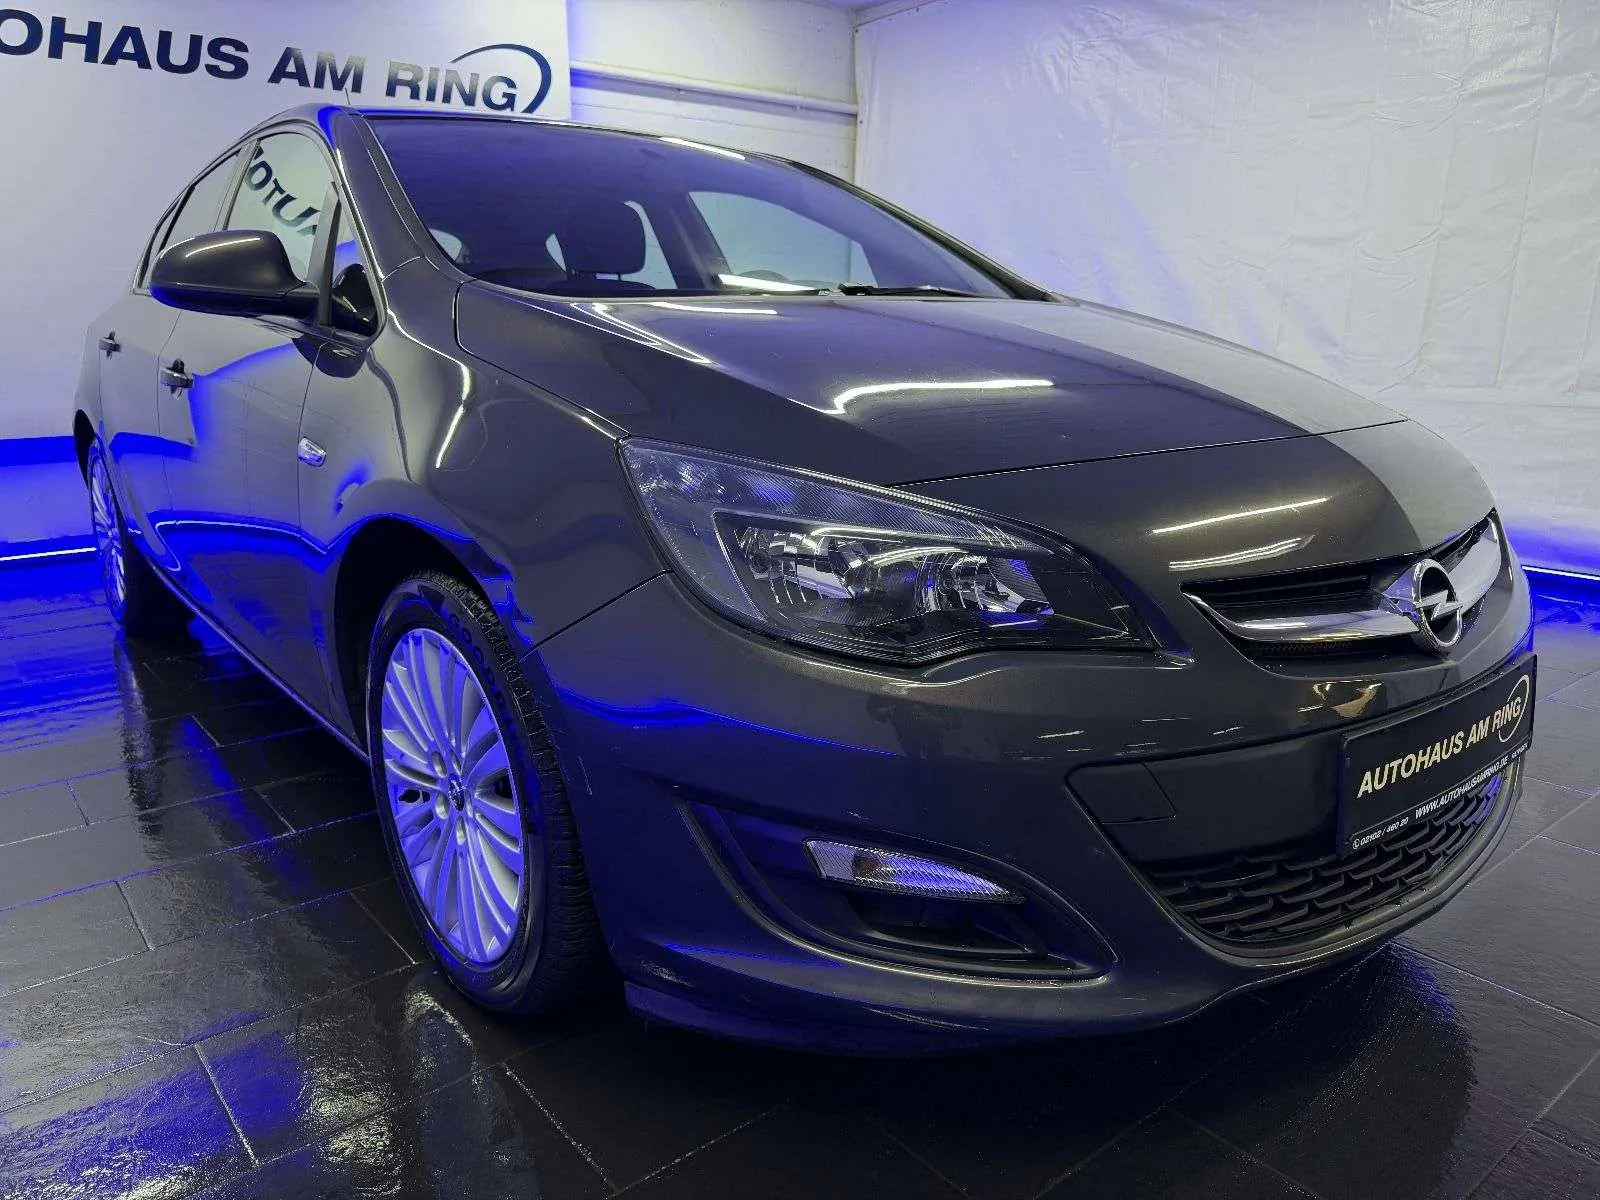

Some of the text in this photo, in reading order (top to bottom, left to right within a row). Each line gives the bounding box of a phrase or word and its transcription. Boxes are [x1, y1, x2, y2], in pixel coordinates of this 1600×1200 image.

[267, 46, 366, 94] AM
[385, 60, 518, 112] RING
[1356, 696, 1522, 799] AUTOHAUS AM RING
